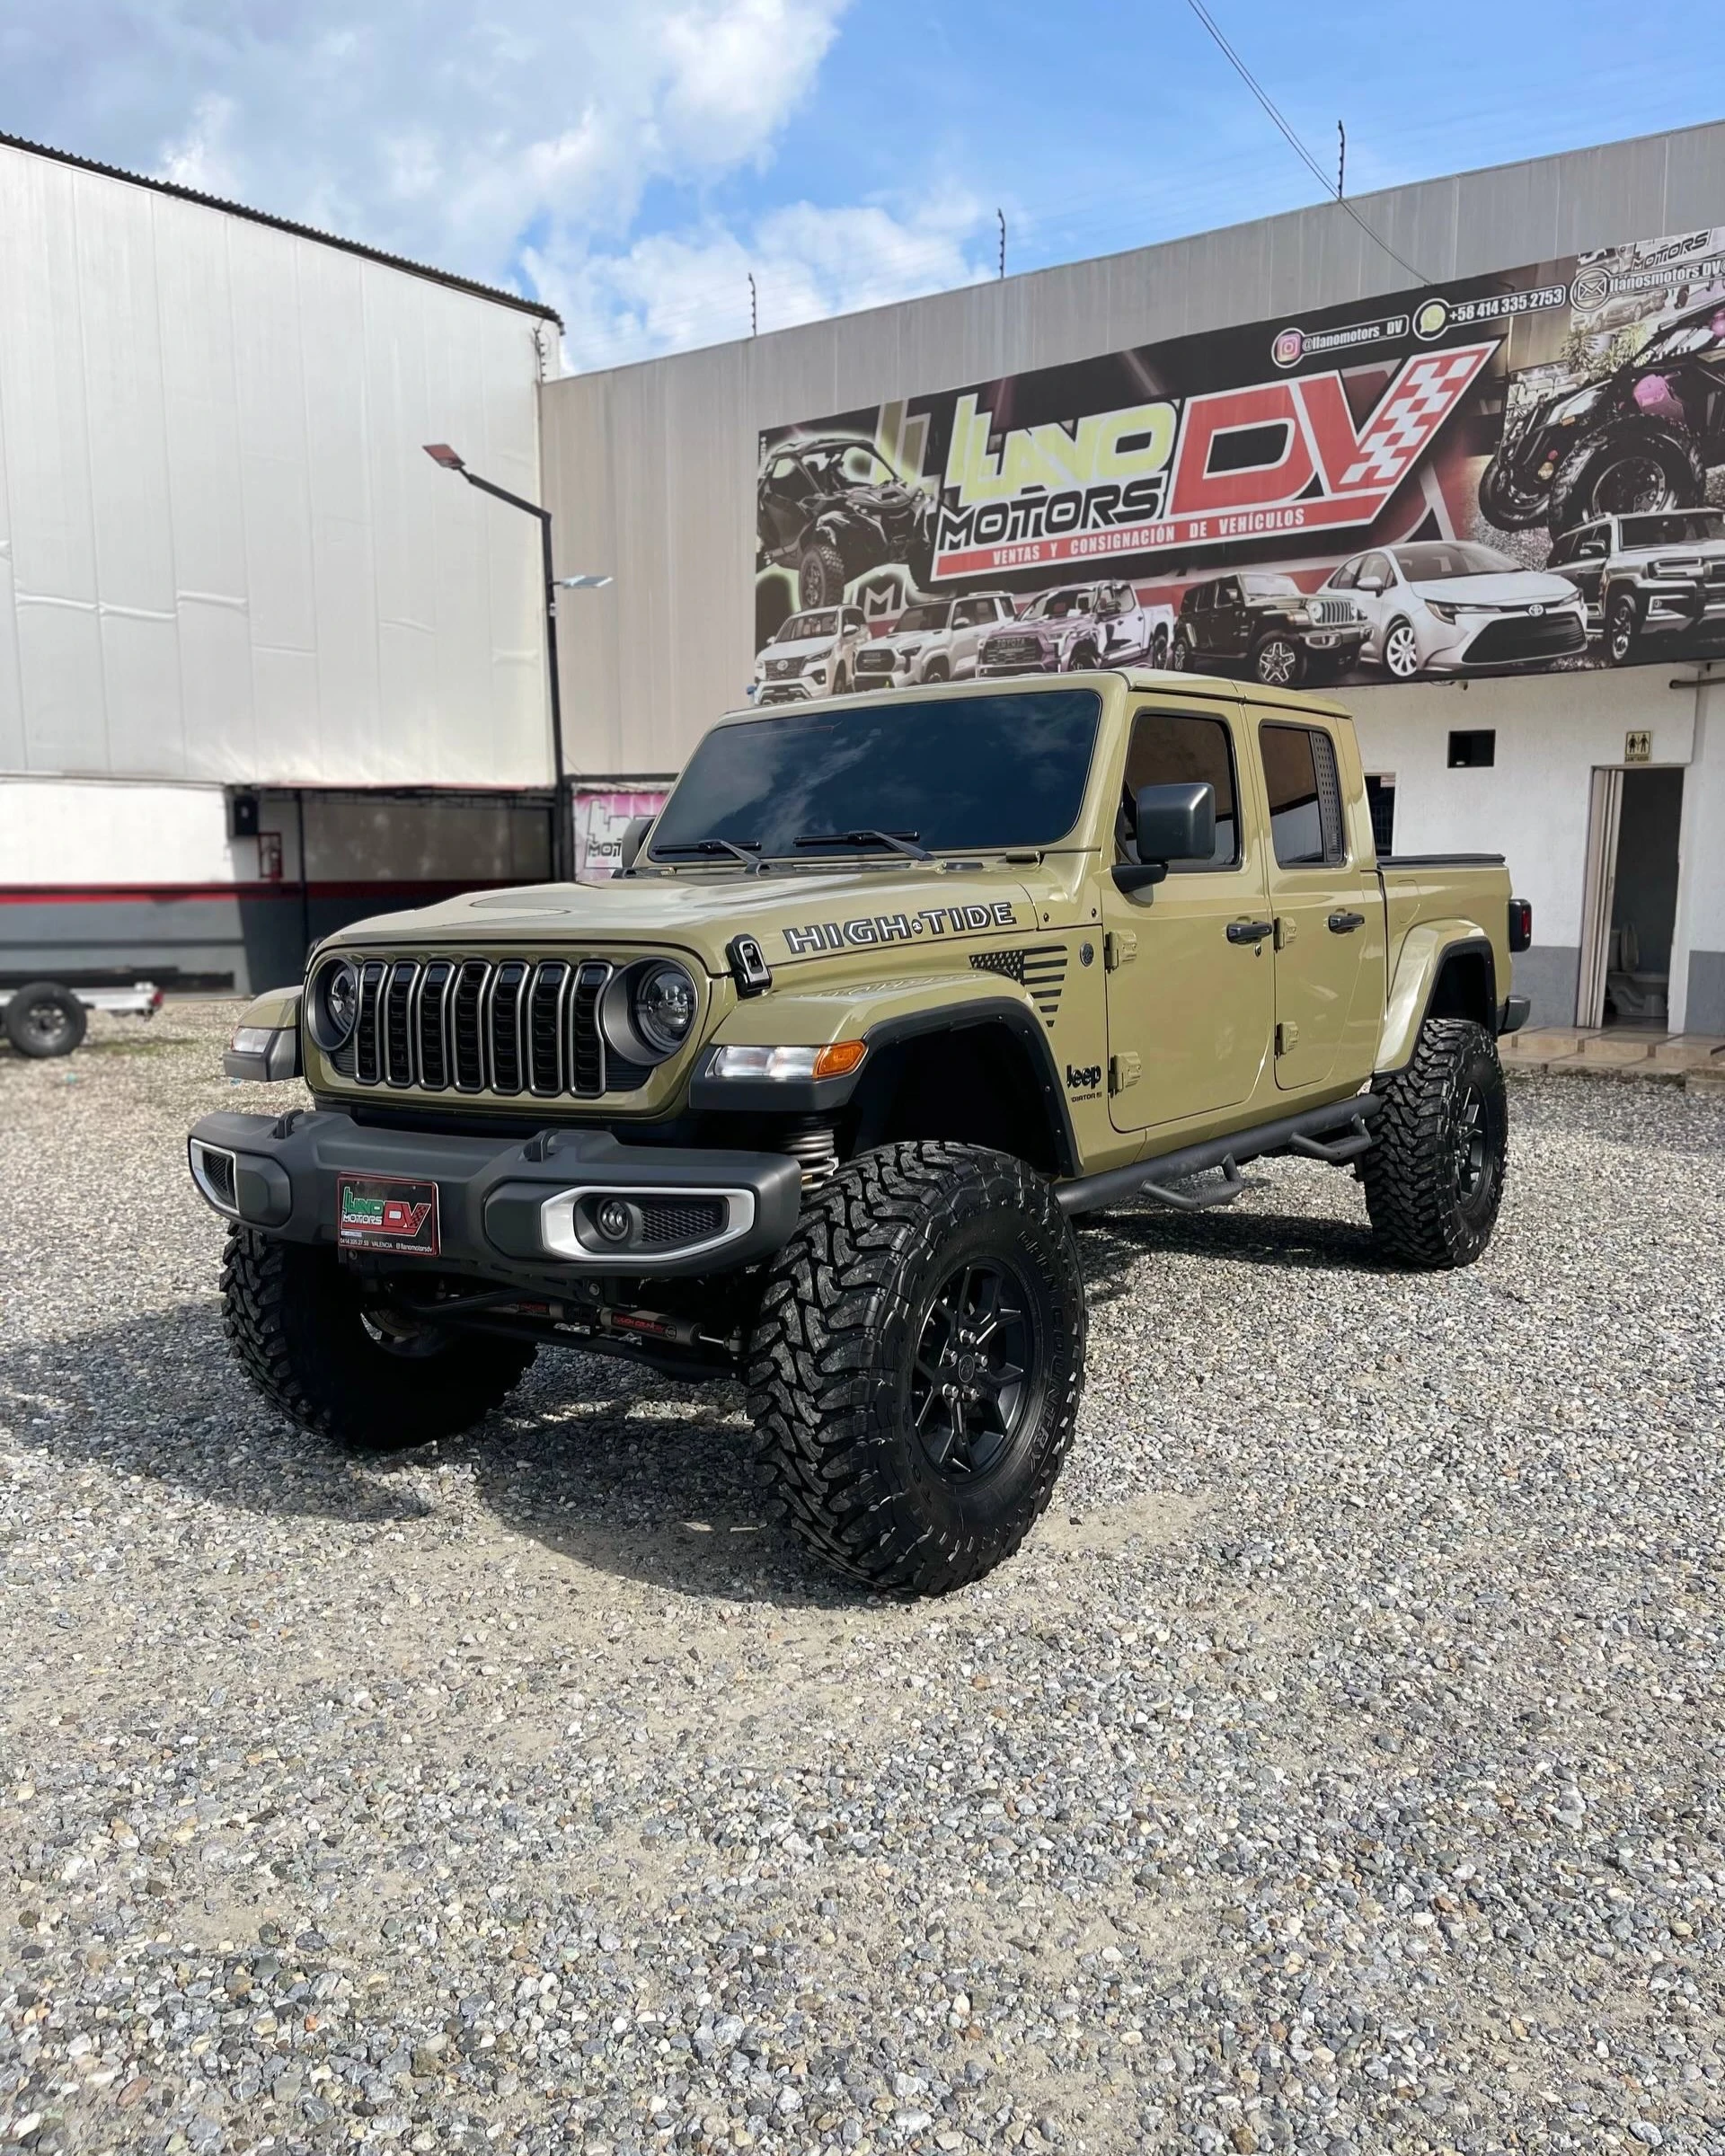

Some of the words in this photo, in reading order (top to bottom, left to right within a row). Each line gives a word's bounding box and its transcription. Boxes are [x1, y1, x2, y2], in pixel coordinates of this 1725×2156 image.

[1449, 305, 1474, 322] +58
[1476, 299, 1499, 317] 414
[1501, 295, 1527, 314] 335
[1529, 287, 1562, 307] 2753
[1169, 340, 1501, 517] DV
[938, 477, 1165, 551] MOTORS
[993, 545, 1040, 565] VENTAS
[1049, 542, 1058, 558] Y
[1070, 524, 1175, 555] CONSIGNACIÓN
[1189, 521, 1208, 539] DE
[1218, 508, 1305, 535] VEHÍCULOS
[1066, 1065, 1101, 1090] Jeep
[343, 1213, 383, 1225] MOTORS
[383, 1200, 431, 1229] DV
[371, 1241, 393, 1249] VALENCIA
